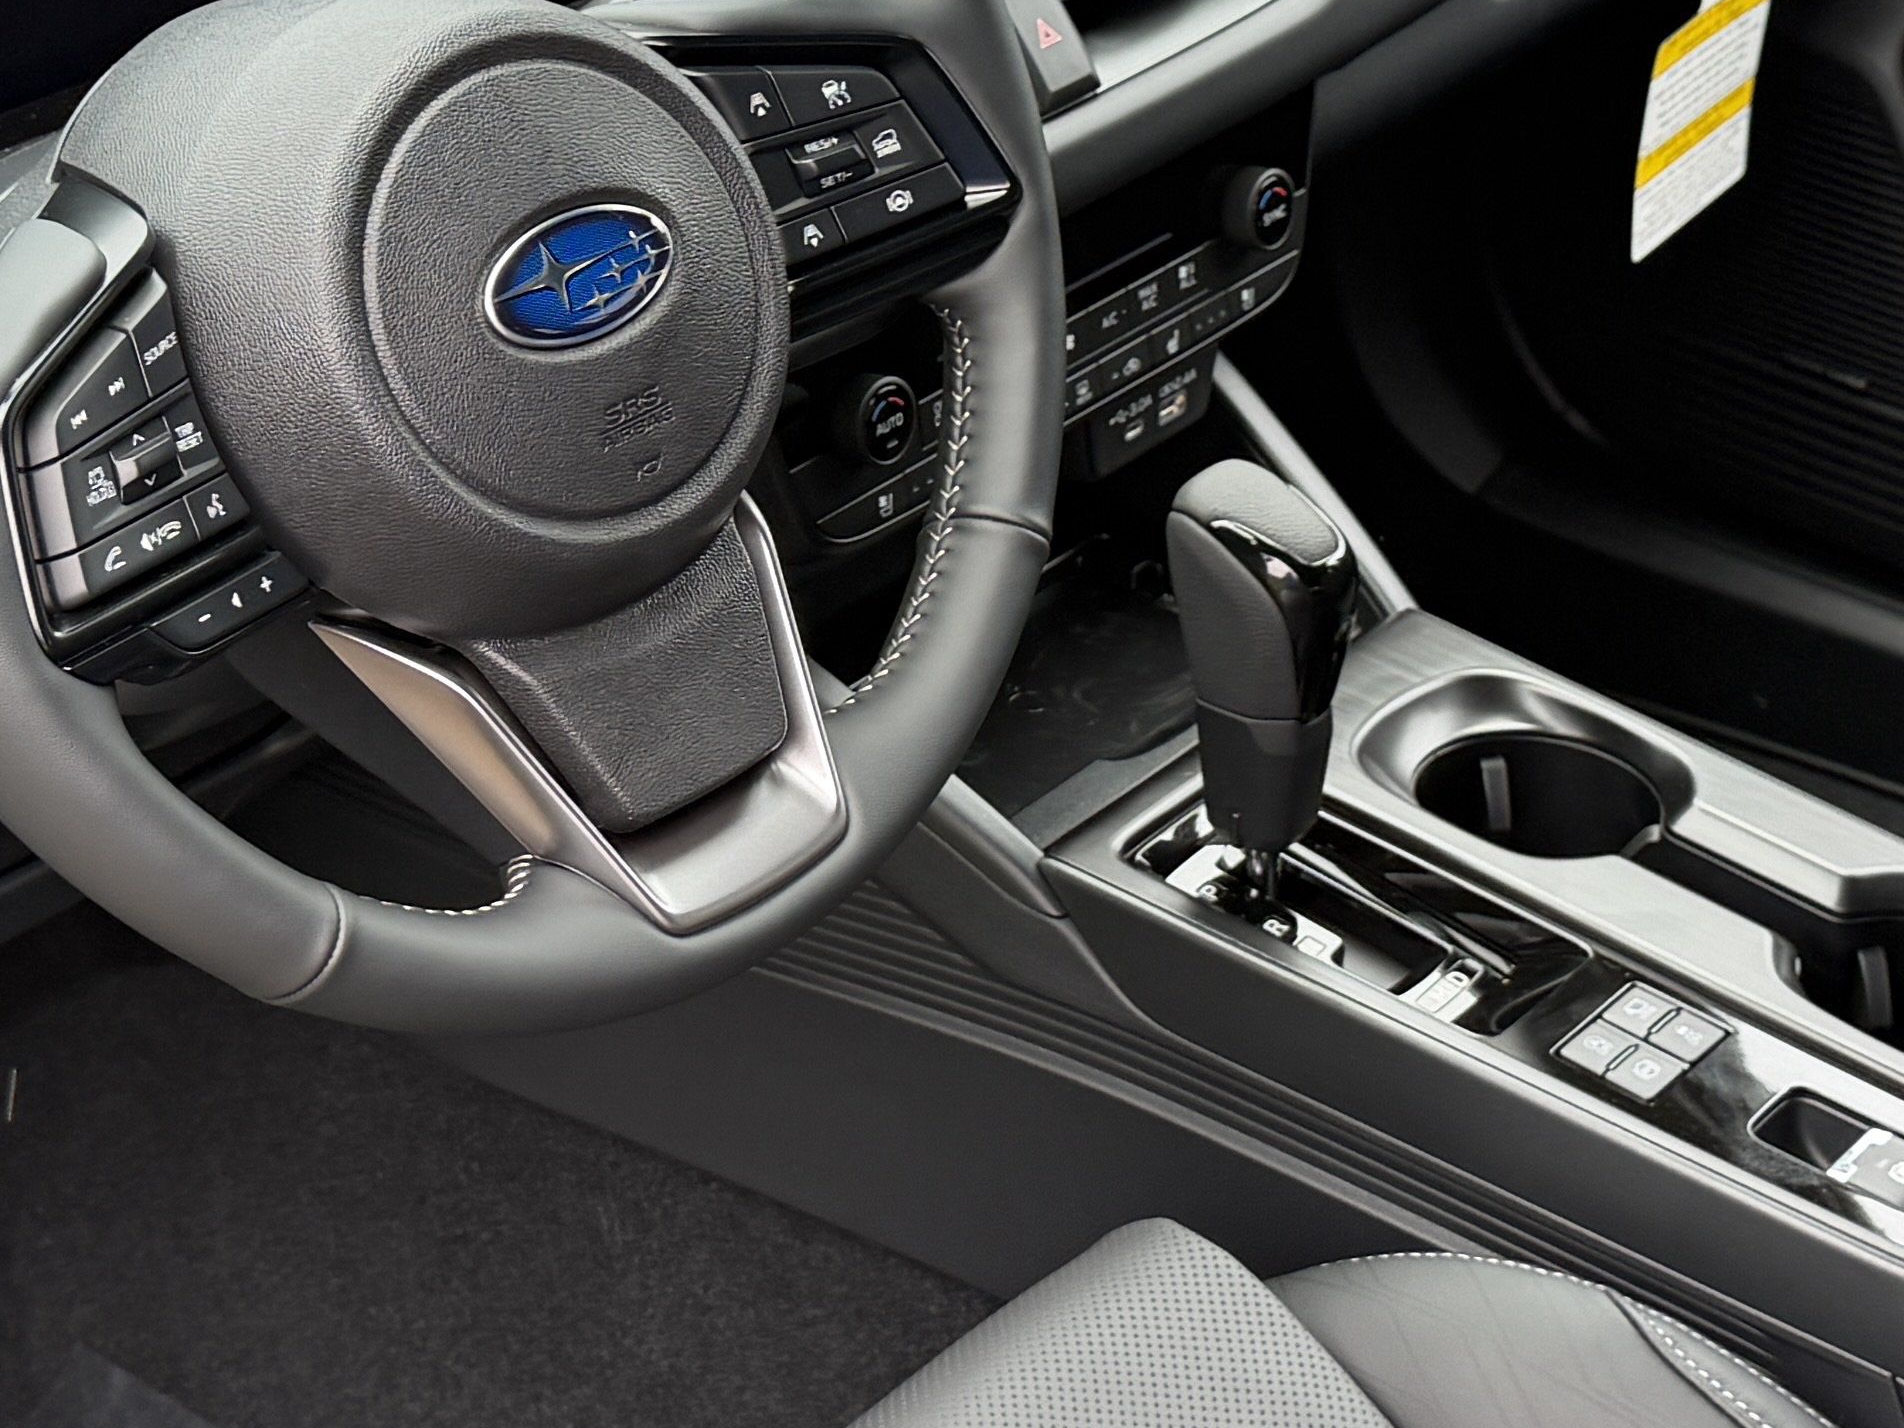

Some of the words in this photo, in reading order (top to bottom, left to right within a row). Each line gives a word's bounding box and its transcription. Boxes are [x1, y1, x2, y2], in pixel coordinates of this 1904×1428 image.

[143, 332, 178, 365] SOURCE
[604, 385, 664, 429] SRS
[603, 407, 677, 454] AIRBAG
[876, 411, 904, 437] AUTO
[1199, 884, 1218, 902] P
[1262, 919, 1290, 937] R
